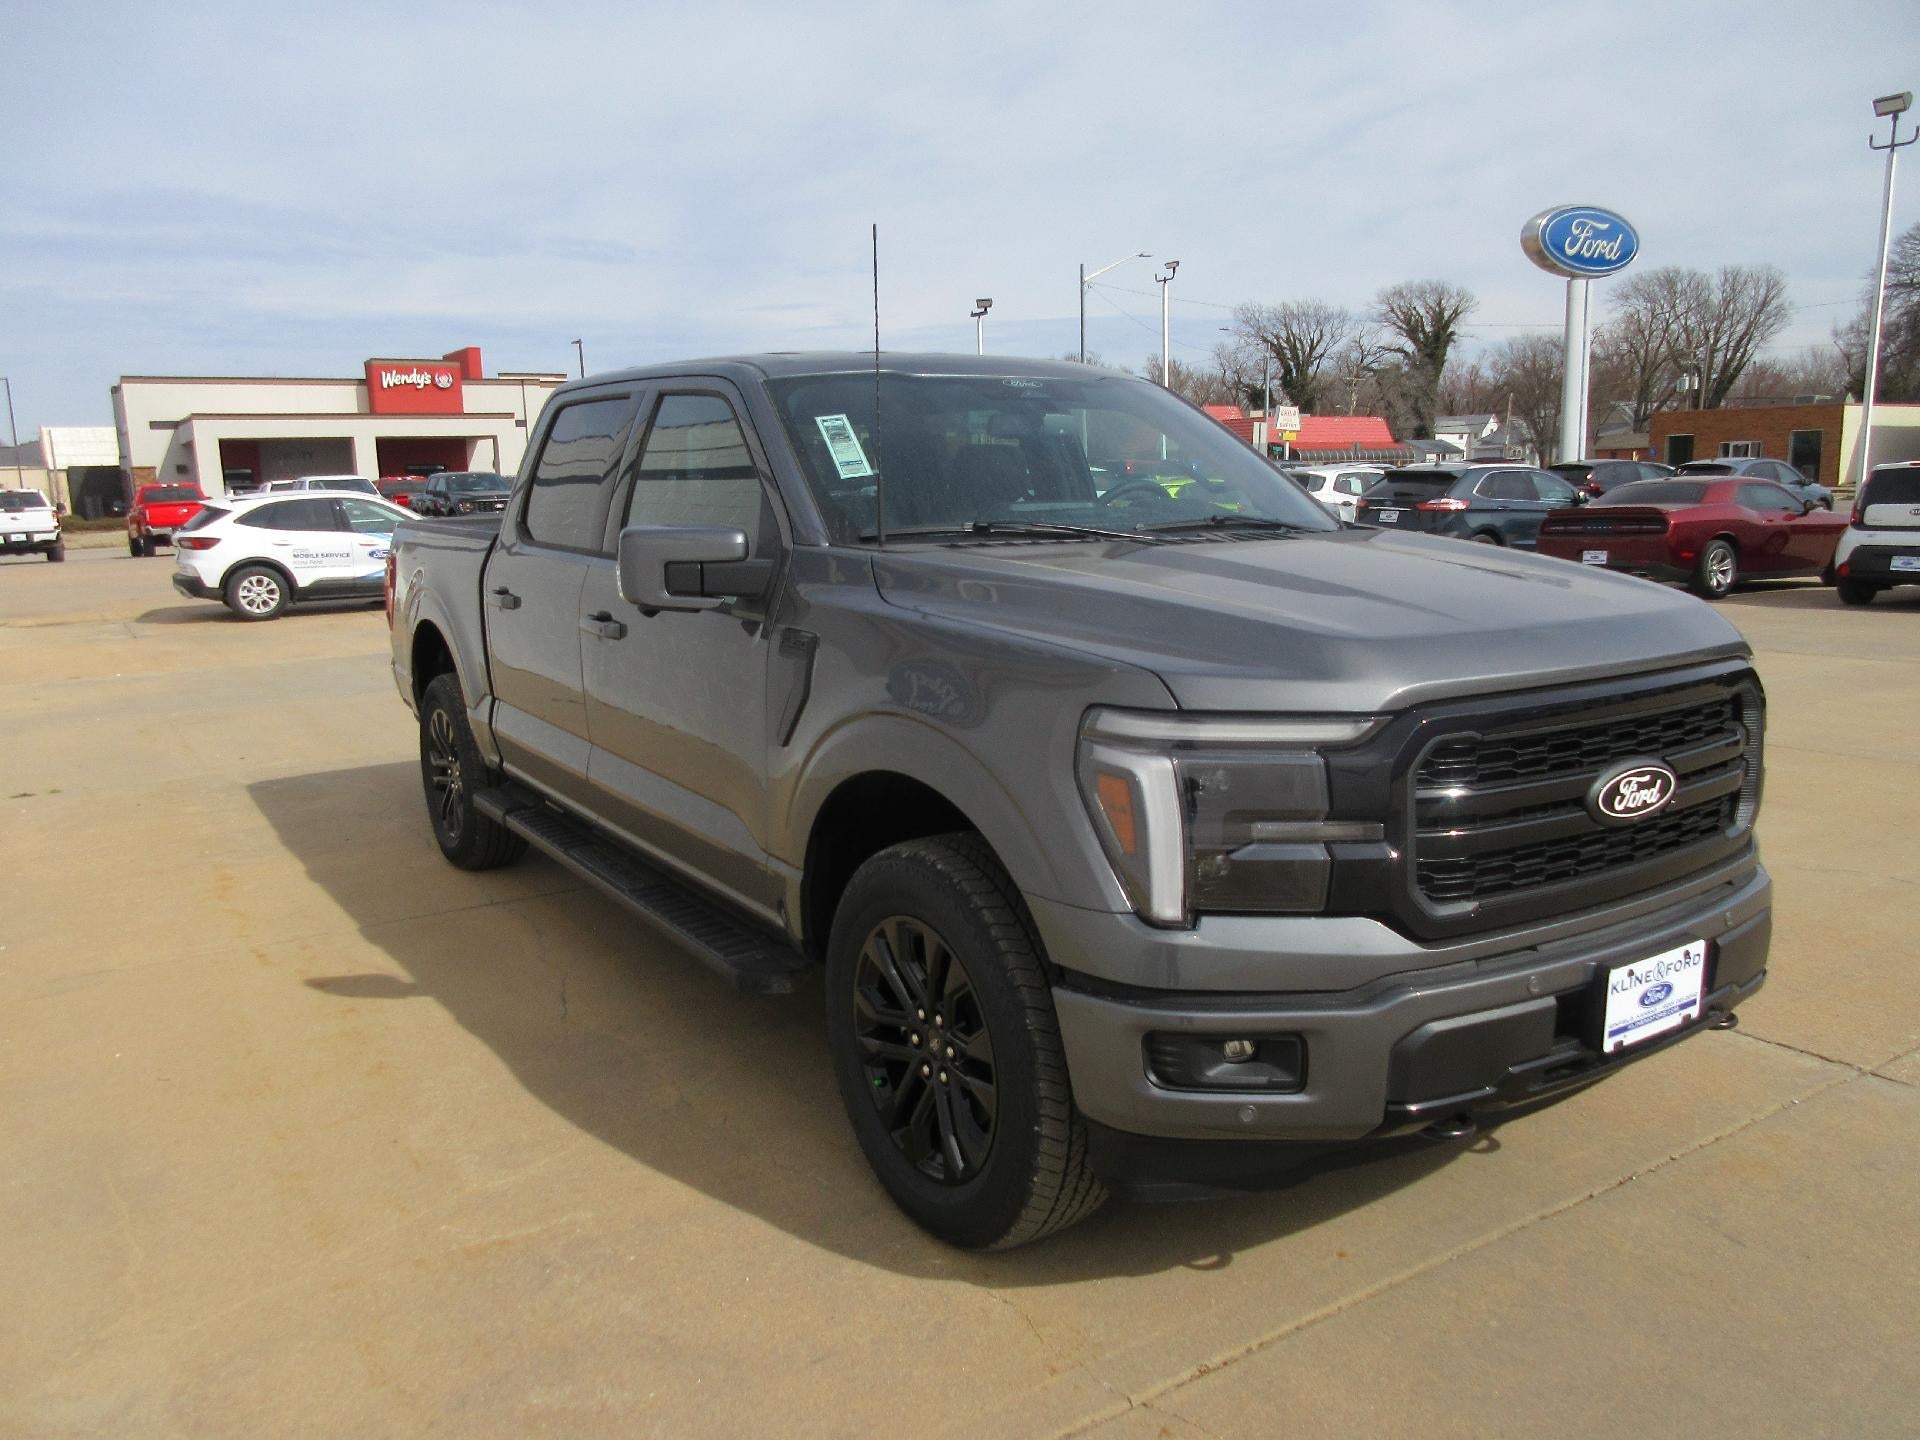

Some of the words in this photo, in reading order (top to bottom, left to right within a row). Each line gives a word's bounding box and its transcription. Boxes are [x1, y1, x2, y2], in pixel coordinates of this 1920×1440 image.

[1565, 218, 1623, 260] Ford
[381, 368, 432, 389] Wendy's
[320, 551, 351, 559] SERVICE
[1614, 774, 1662, 811] Ford
[1610, 970, 1653, 996] KLINE
[1665, 953, 1701, 977] FORD
